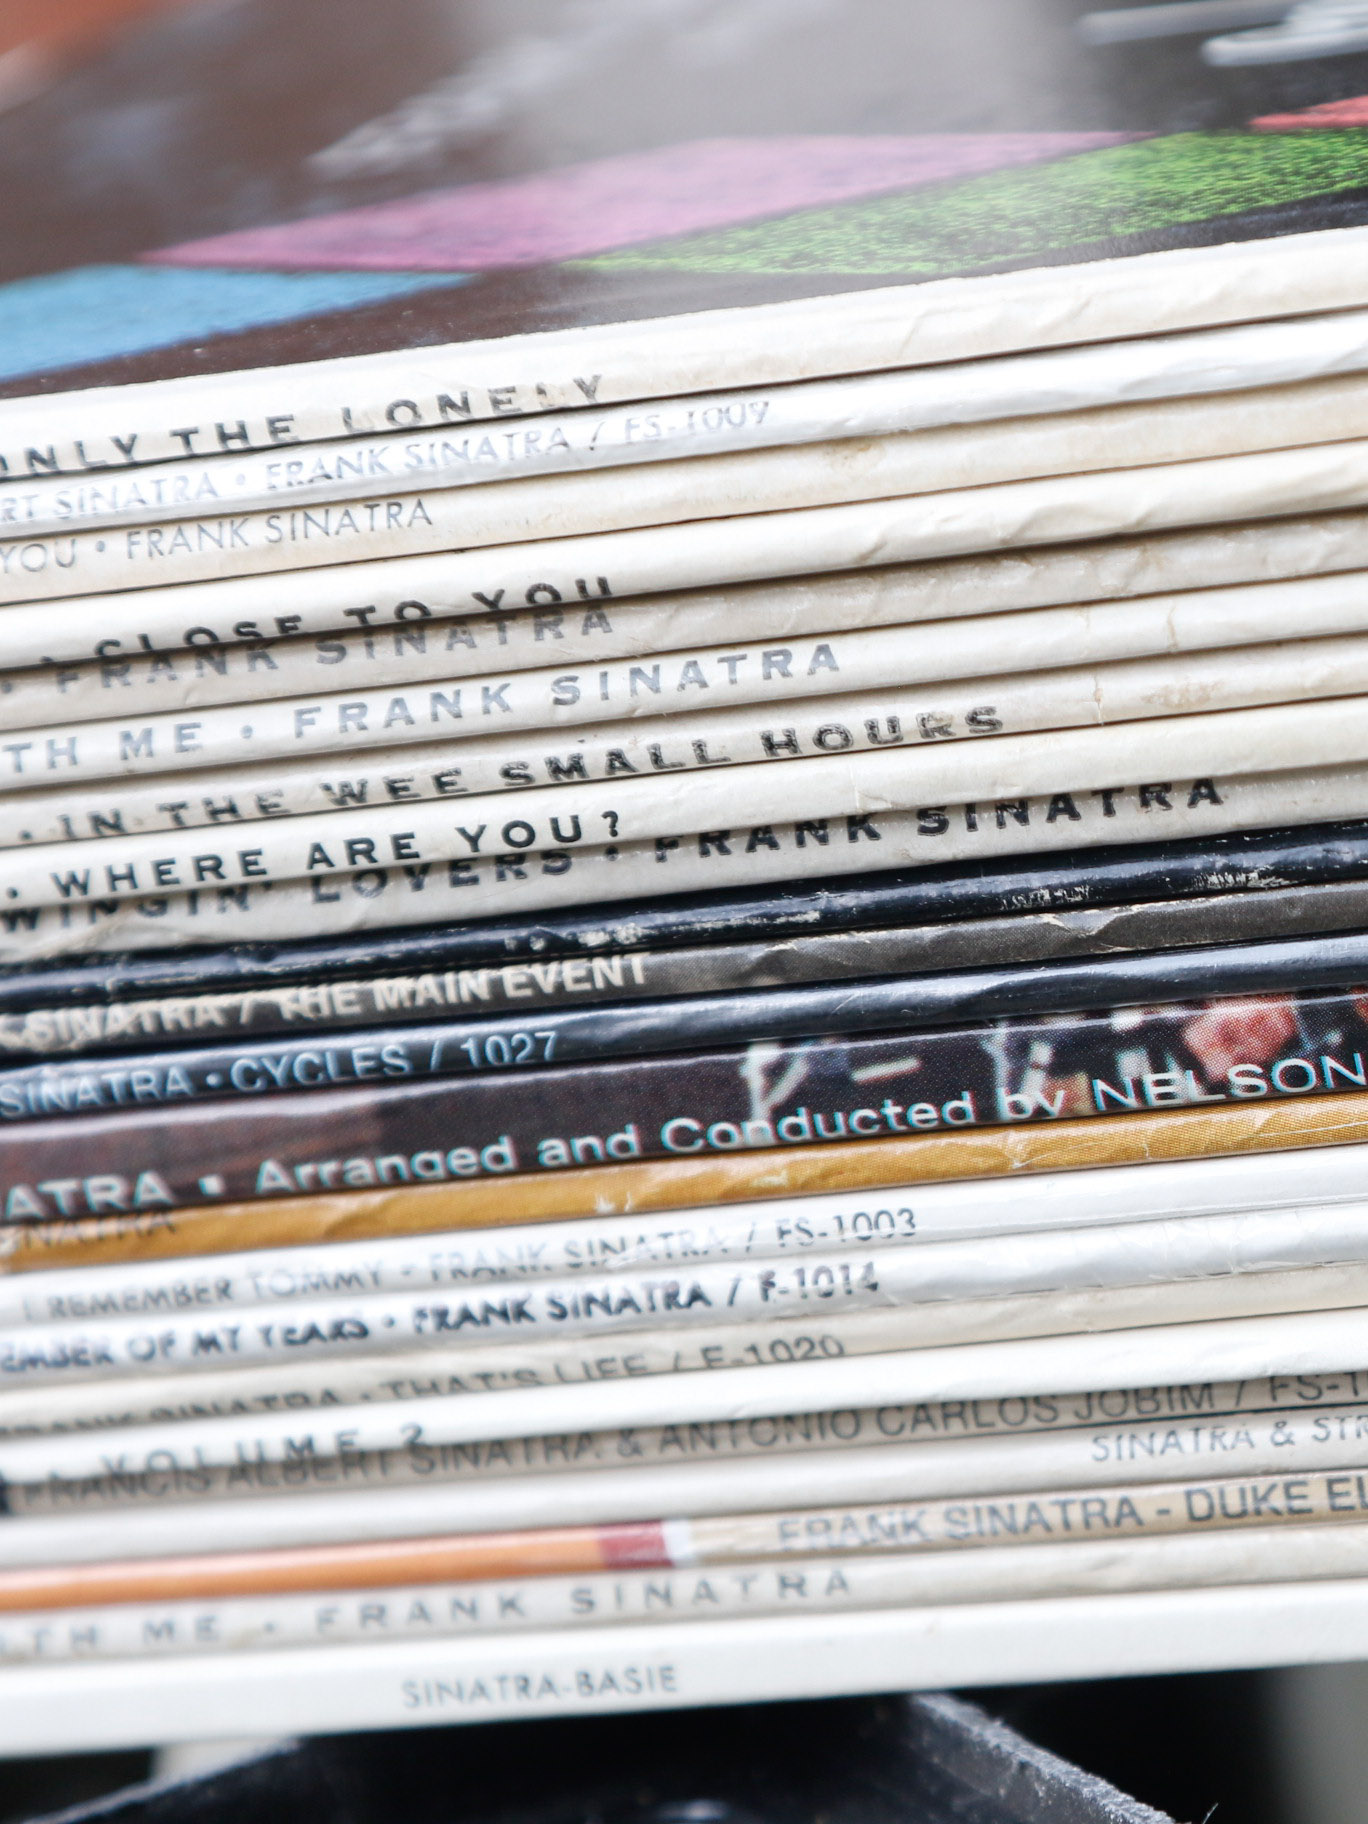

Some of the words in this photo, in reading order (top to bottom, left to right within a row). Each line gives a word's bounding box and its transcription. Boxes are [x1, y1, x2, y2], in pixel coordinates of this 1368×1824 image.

[0, 432, 137, 477] NLY
[169, 413, 299, 456] THE
[52, 470, 219, 518] SINATRA
[265, 446, 391, 490] FRANK
[403, 426, 570, 472] SINATRA
[623, 400, 770, 445] FS-1009
[0, 538, 77, 574] YOU
[126, 517, 250, 561] FRANK
[264, 498, 433, 543] SINATRA
[55, 642, 280, 695] FRANK
[314, 604, 614, 666] SINATRA
[94, 614, 304, 657] CLOSE
[343, 600, 433, 627] TO
[471, 576, 614, 612] YOU
[3, 735, 78, 773] TH
[118, 722, 205, 762] ME
[293, 683, 512, 739] FRANK
[550, 643, 841, 707] SINATRA
[57, 806, 127, 842] IN
[157, 788, 293, 828] THE
[320, 766, 468, 807] WEE
[499, 738, 732, 787] SMALL
[759, 705, 1004, 758] HOURS
[49, 847, 268, 898] WHERE
[306, 831, 422, 870] ARE
[455, 810, 620, 853] YOU?
[312, 848, 573, 905] LOVERS
[654, 815, 882, 864] FRANK
[916, 777, 1223, 837] SINATRA
[25, 995, 226, 1046] SINATRA
[372, 970, 491, 1012] MAIN
[502, 952, 650, 999] EVENT
[0, 1066, 195, 1118] SINATRA
[229, 1044, 413, 1092] CYCLES
[460, 1030, 559, 1068] 1027
[255, 1135, 519, 1194] Arranged
[536, 1122, 644, 1168] and
[660, 1089, 977, 1153] Conducted
[1092, 1051, 1368, 1112] NELSON
[48, 1276, 233, 1320] REMEMBER
[246, 1260, 384, 1300] TOMMY
[428, 1241, 554, 1283] FRANK
[562, 1228, 730, 1271] SINATRA
[775, 1207, 917, 1253] FS-1003
[126, 1330, 176, 1362] OF
[192, 1324, 242, 1358] MY
[259, 1317, 370, 1349] YEARS
[413, 1293, 537, 1335] FRANK
[546, 1278, 713, 1322] SINATRA
[658, 1408, 862, 1455] ANTONIO
[875, 1394, 1060, 1436] CARLOS
[1073, 1381, 1215, 1421] JOBIM
[1090, 1426, 1256, 1463] SINATRA
[1270, 1419, 1296, 1447] &
[776, 1506, 933, 1552] FRANK
[943, 1494, 1146, 1542] SINATRA
[1184, 1479, 1315, 1523] DUKE
[143, 1614, 221, 1646] ME
[315, 1592, 527, 1635] FRANK
[570, 1569, 852, 1616] SINATRA
[400, 1663, 679, 1710] SINATRA-BASIE
